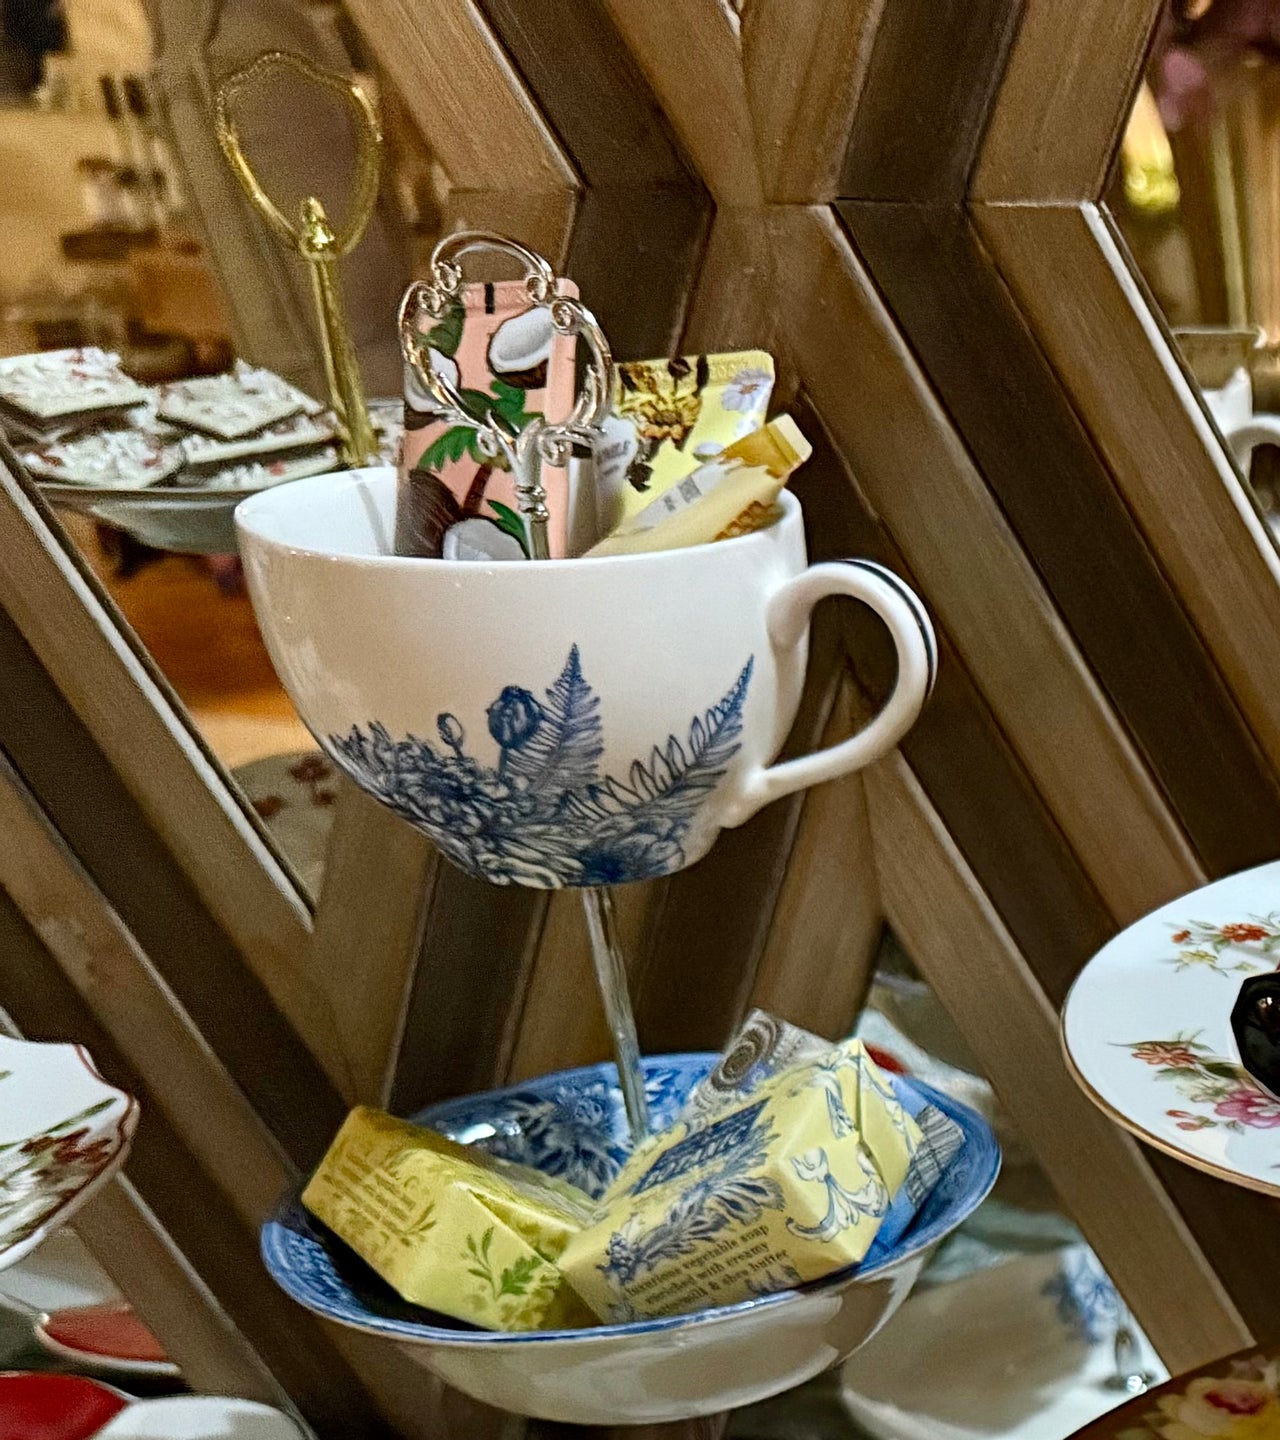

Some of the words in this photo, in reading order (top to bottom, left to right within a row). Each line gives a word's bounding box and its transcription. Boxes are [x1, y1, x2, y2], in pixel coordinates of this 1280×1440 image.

[740, 1224, 769, 1243] soap
[696, 1262, 725, 1279] with
[749, 1250, 789, 1273] butter
